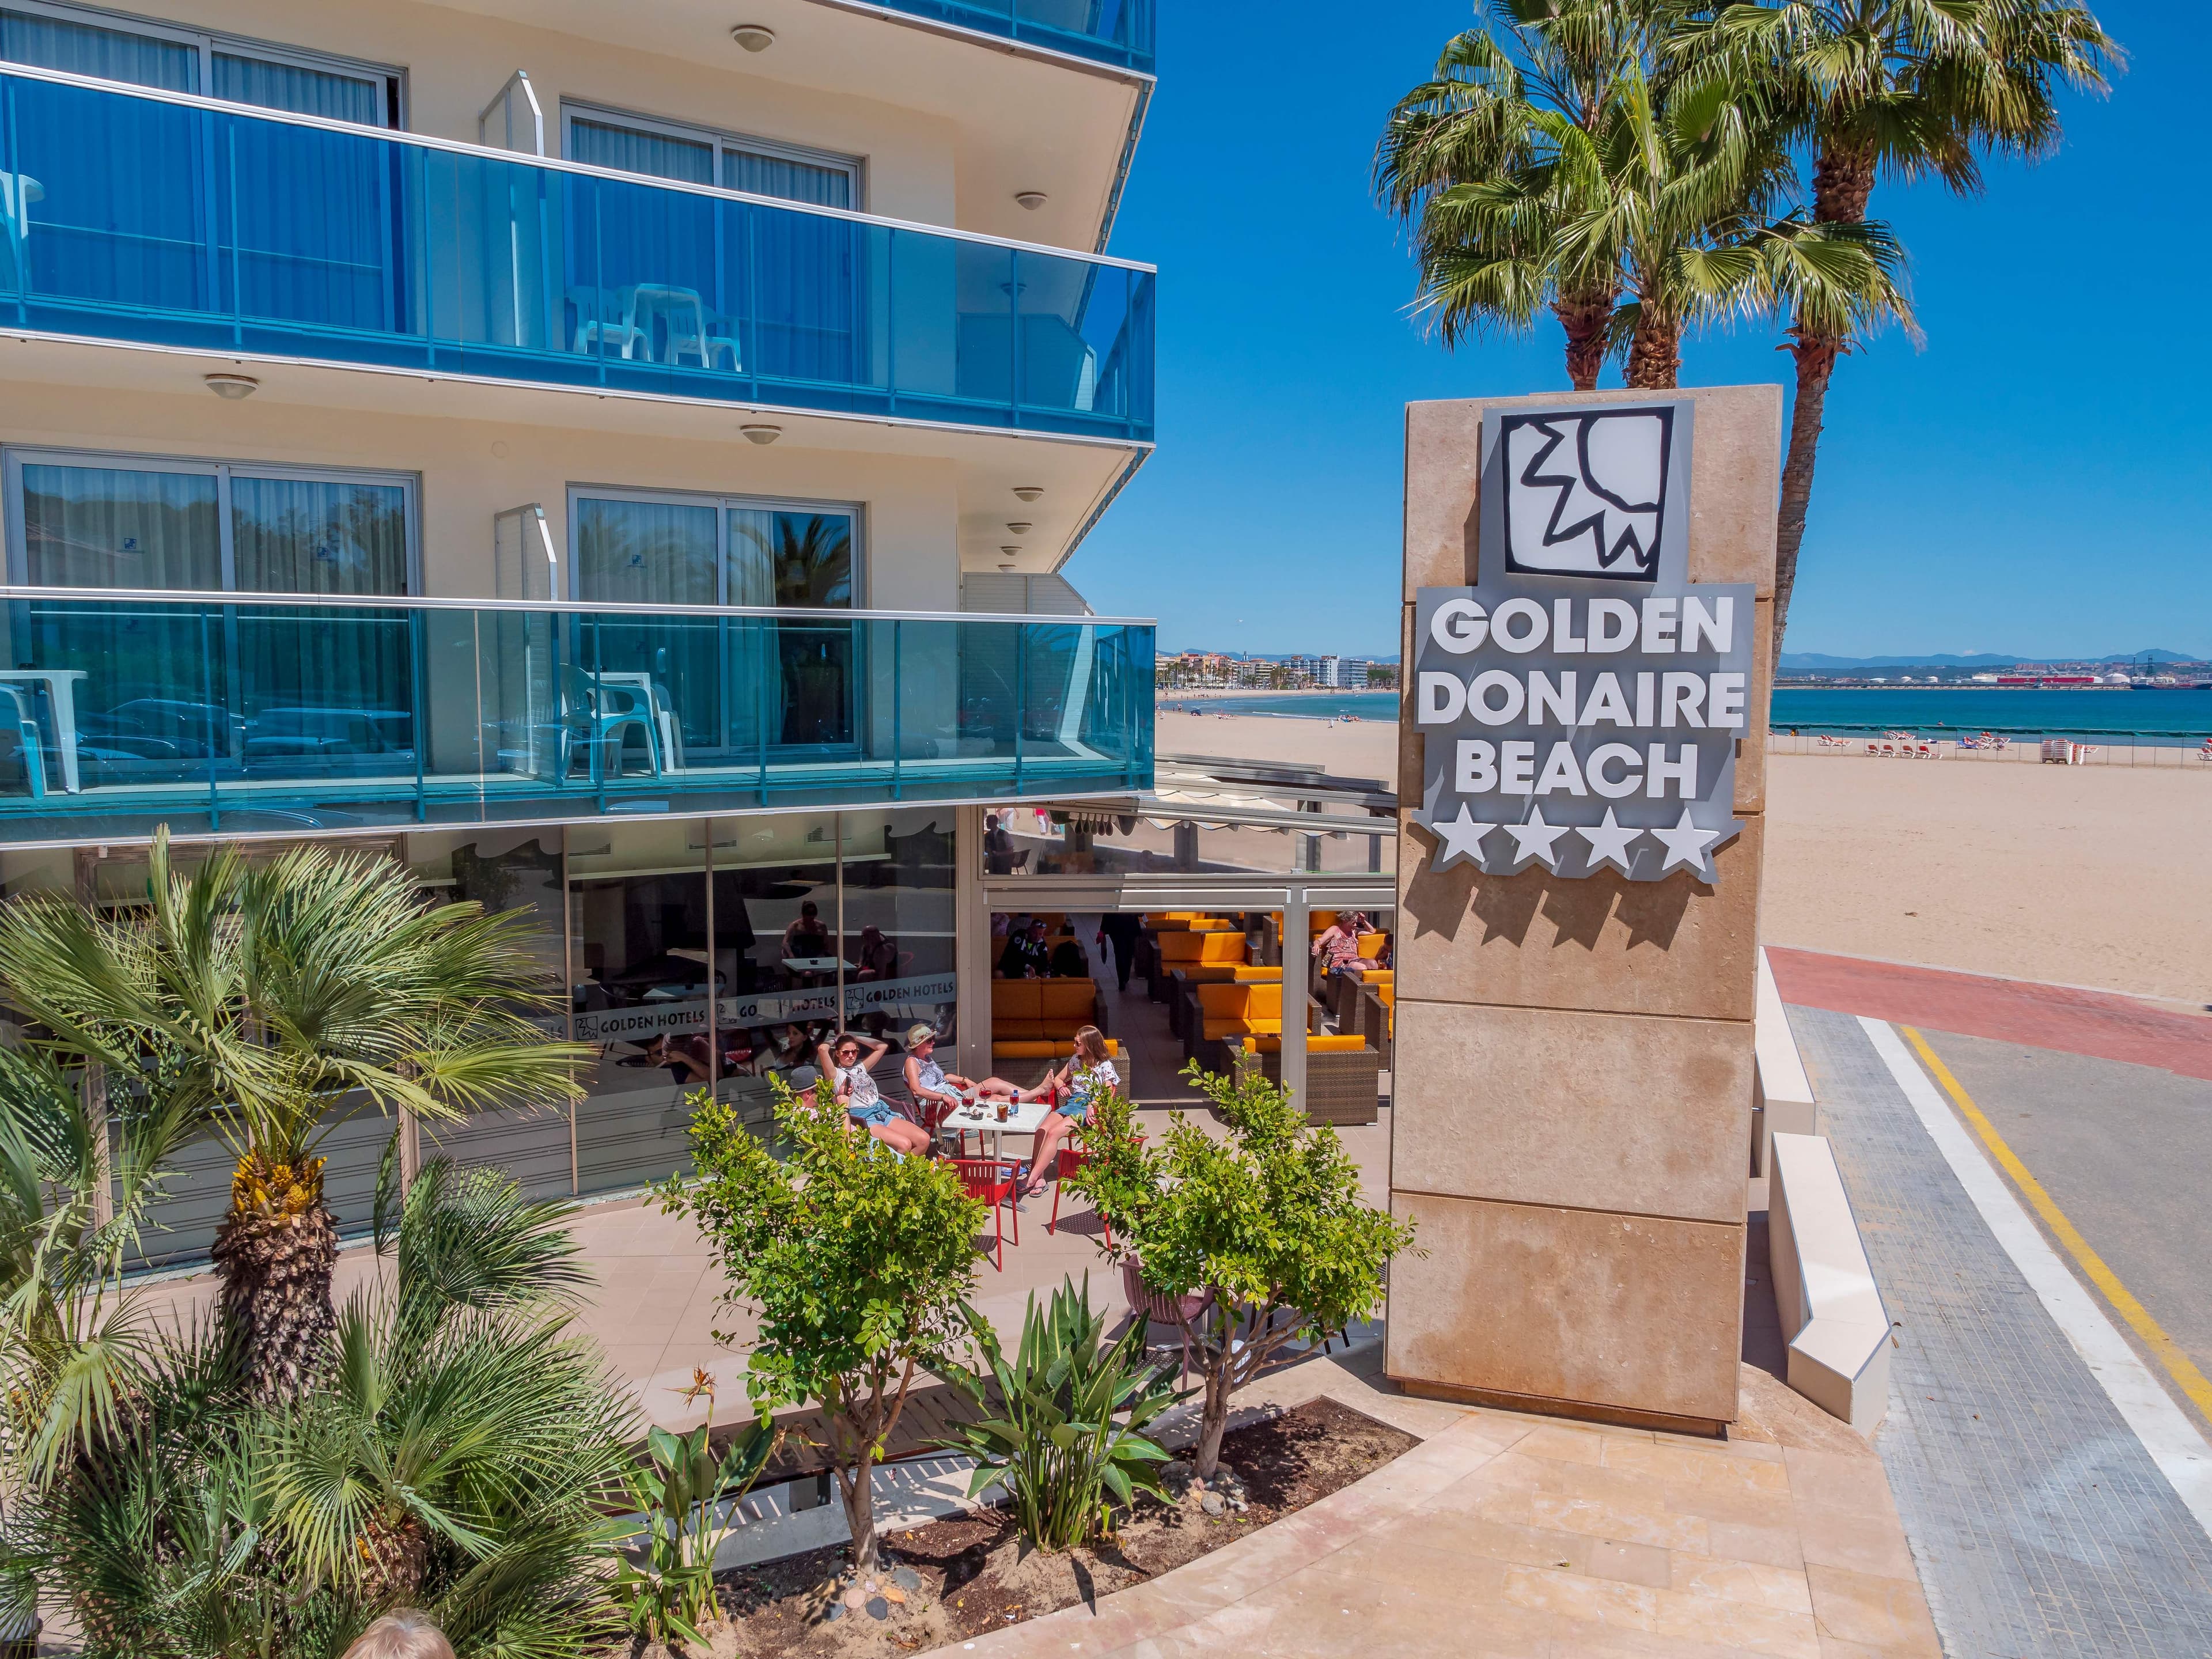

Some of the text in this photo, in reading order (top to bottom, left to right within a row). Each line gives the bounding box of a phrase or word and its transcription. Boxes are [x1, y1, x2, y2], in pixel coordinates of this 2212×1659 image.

[1430, 597, 1733, 654] GOLDEN
[1418, 669, 1745, 728] DONAIRE
[1455, 739, 1698, 800] BEACH
[866, 981, 953, 1003] GOLDEN HOTELS
[601, 1010, 705, 1033] GOLDEN HOTELS
